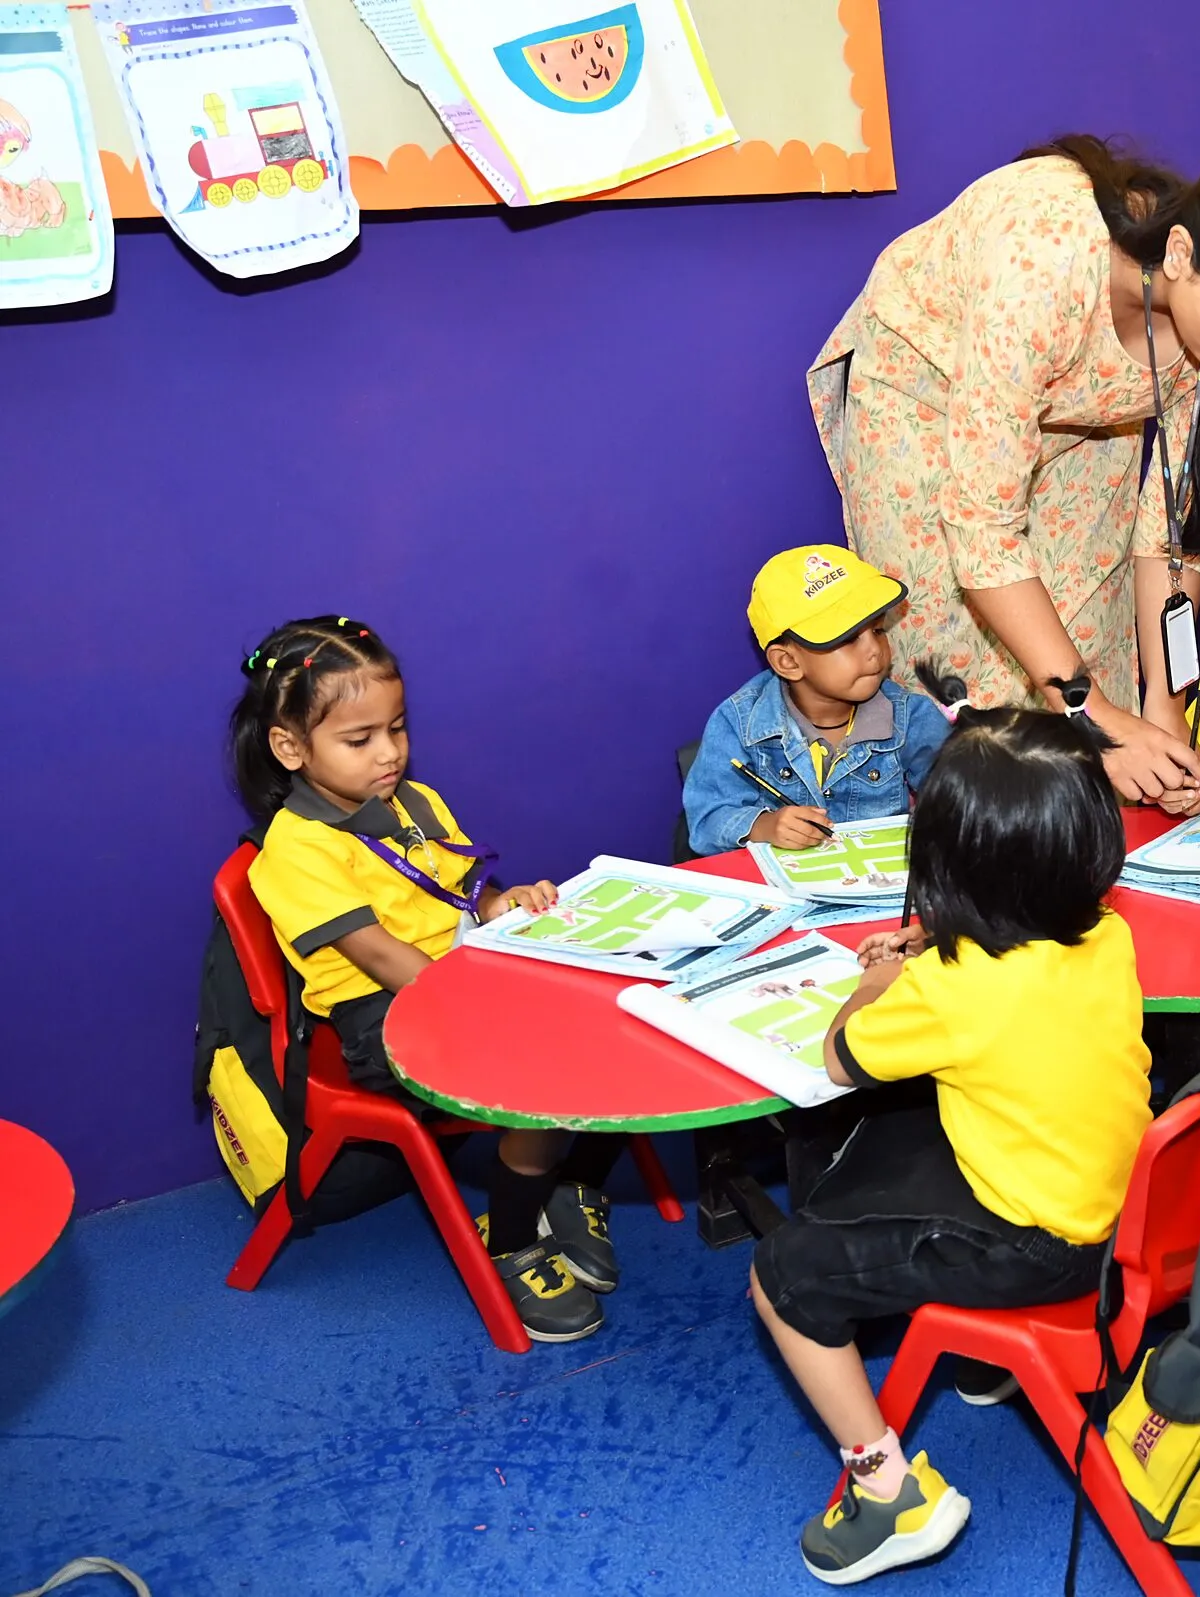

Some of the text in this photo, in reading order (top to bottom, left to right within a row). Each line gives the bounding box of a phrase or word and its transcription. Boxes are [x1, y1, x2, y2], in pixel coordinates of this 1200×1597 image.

[138, 29, 157, 37] Trace
[207, 20, 219, 28] and
[219, 18, 236, 27] colour
[804, 567, 846, 598] KIDZEE
[394, 858, 421, 879] KIDZEE
[209, 1094, 249, 1166] KIDZEE
